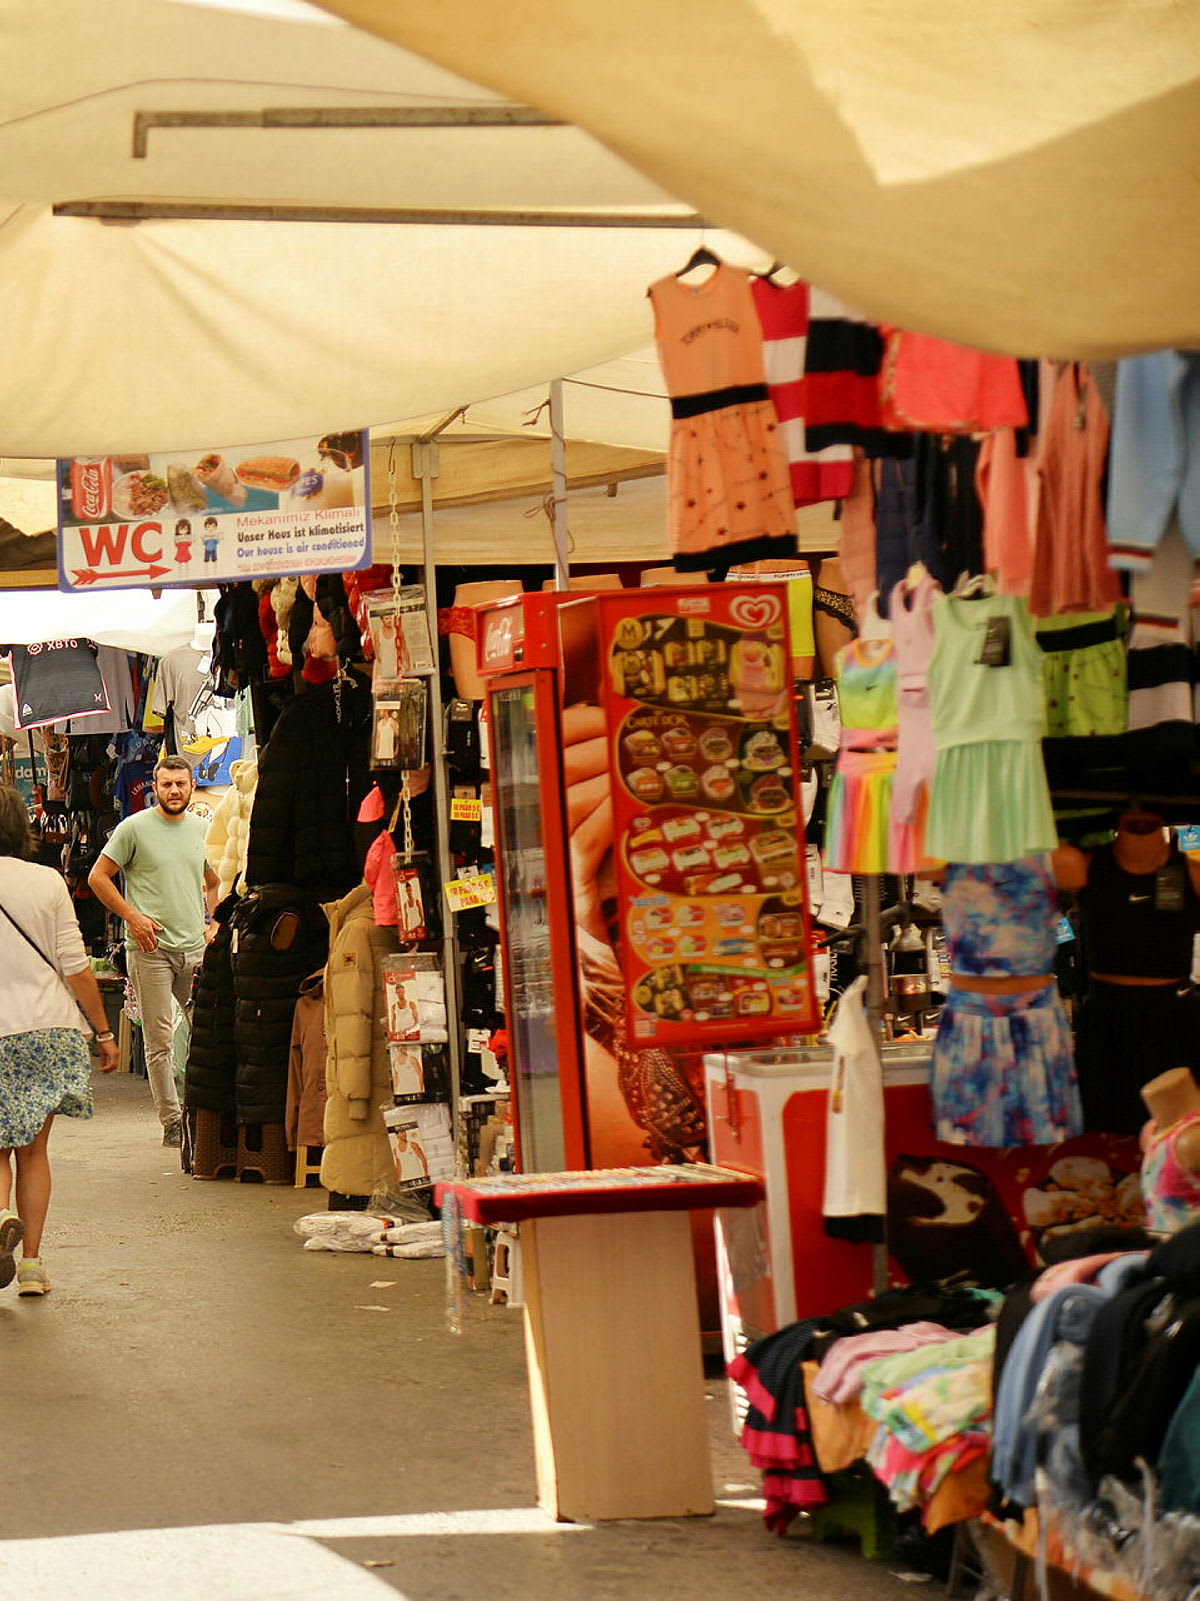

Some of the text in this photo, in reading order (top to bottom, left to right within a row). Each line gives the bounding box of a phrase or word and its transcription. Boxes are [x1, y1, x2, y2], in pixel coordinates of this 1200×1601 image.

[237, 522, 365, 543] Unser Haus ist klimatisiert
[79, 521, 163, 567] WC
[237, 537, 365, 558] Our house is air conditioned
